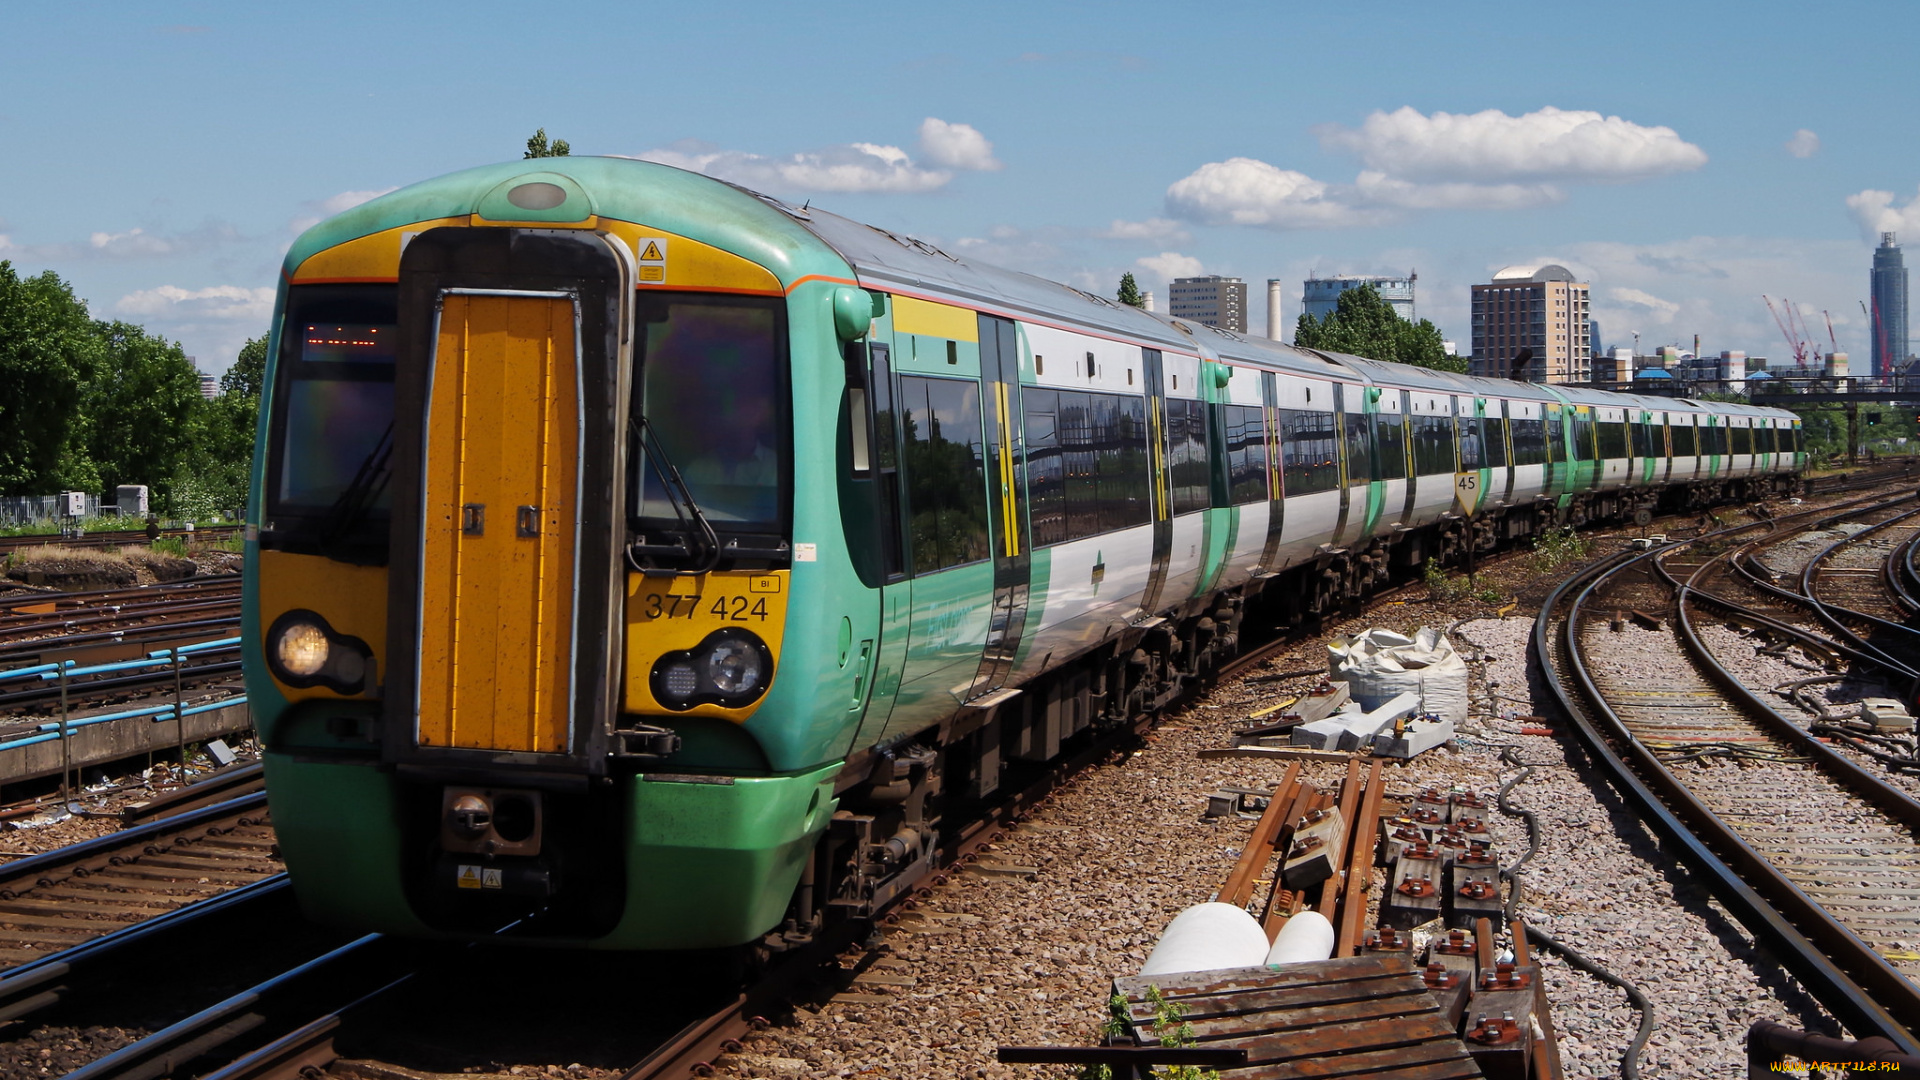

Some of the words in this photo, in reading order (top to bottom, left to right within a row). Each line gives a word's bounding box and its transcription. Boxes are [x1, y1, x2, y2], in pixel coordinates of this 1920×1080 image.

[1458, 476, 1476, 490] 45
[645, 593, 702, 620] 377
[710, 595, 769, 622] 424
